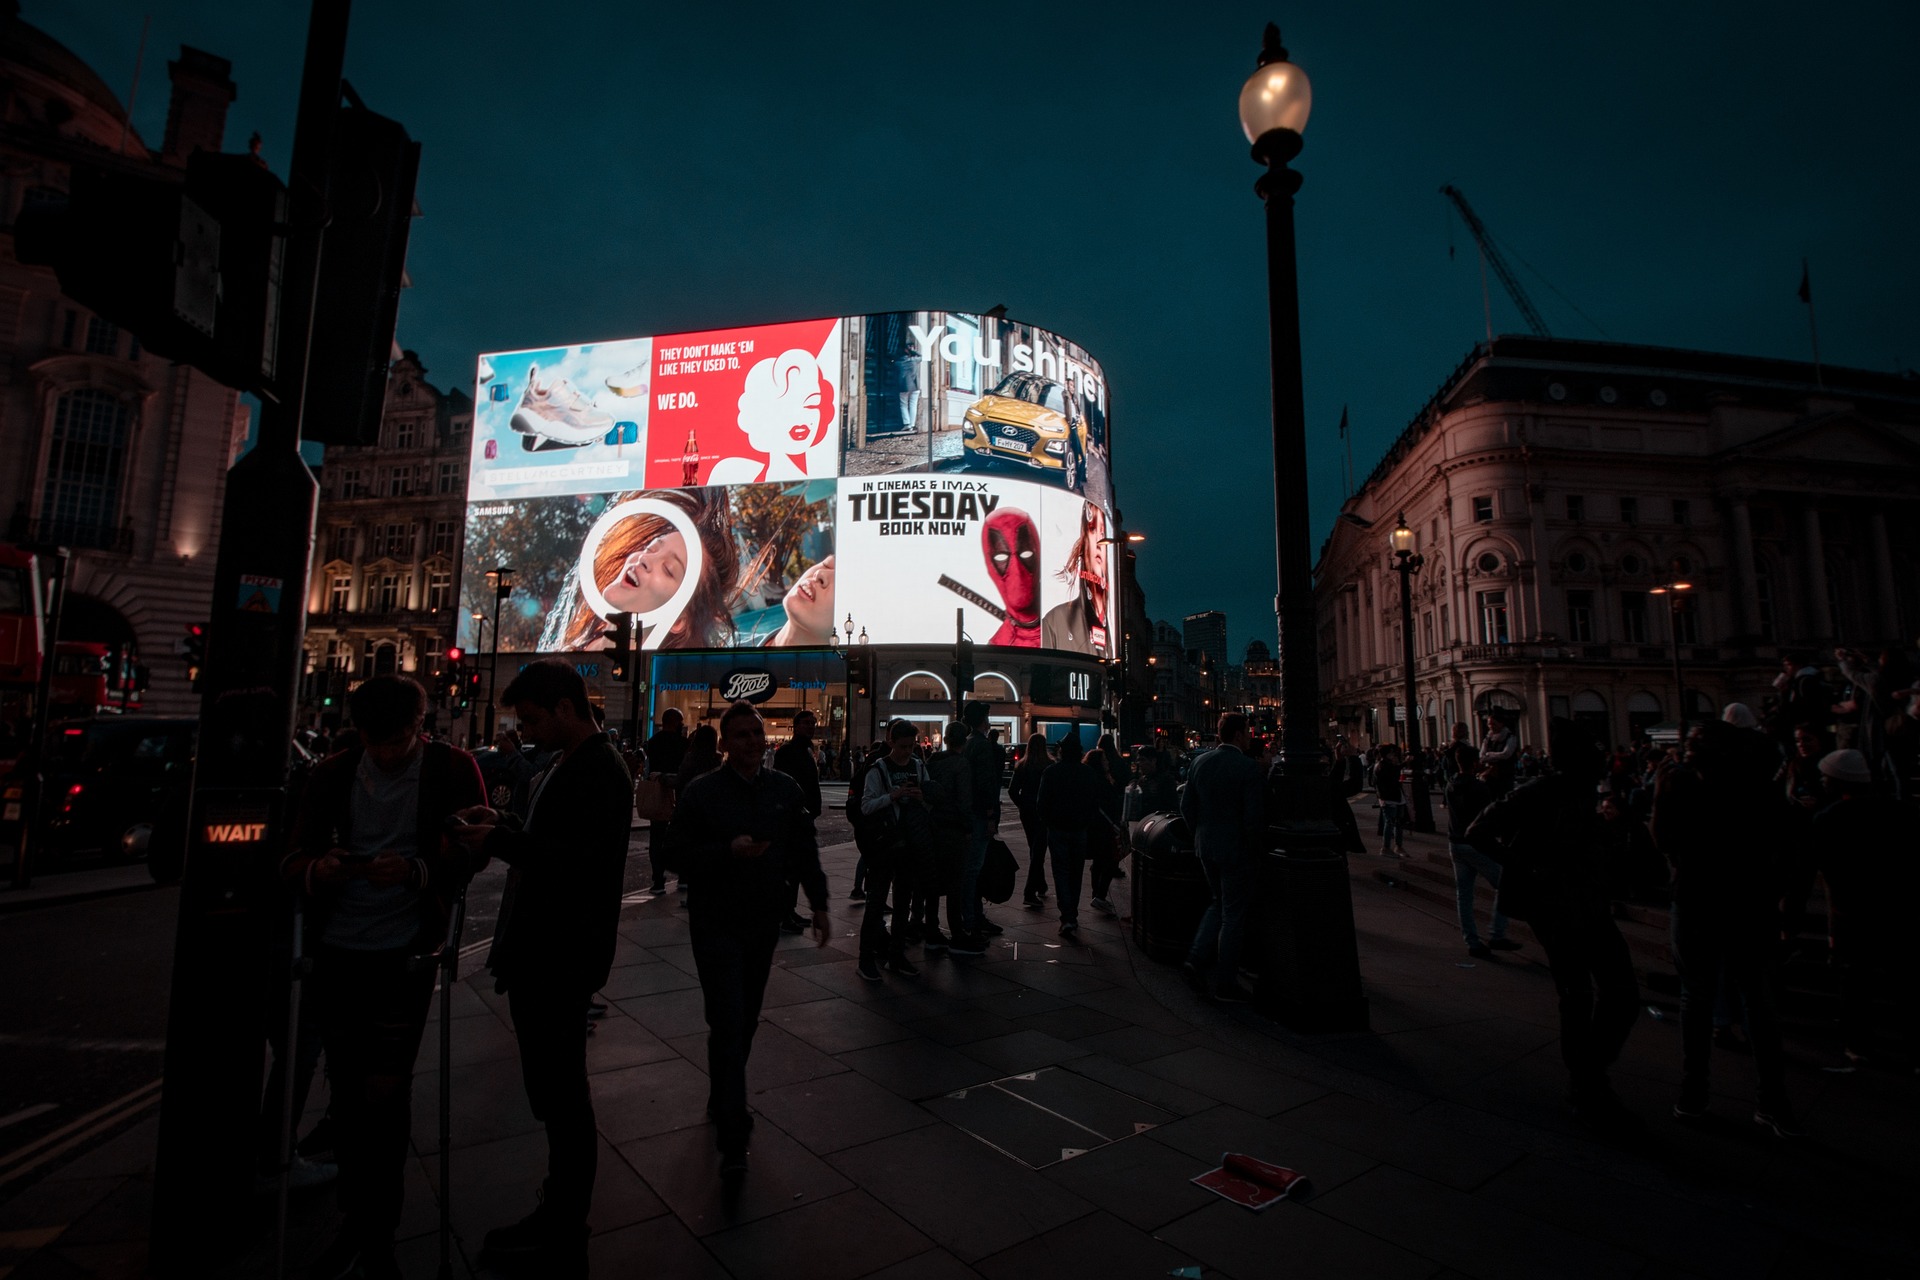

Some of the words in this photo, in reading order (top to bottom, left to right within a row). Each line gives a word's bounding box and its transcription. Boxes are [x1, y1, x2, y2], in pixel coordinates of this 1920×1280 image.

[659, 347, 682, 361] THEY
[683, 344, 709, 359] DON'T
[710, 341, 736, 357] MAKE
[737, 340, 754, 354] 'EM
[909, 325, 1000, 367] You
[659, 362, 678, 376] LIKE
[679, 360, 702, 374] THEY
[703, 358, 726, 372] USED
[727, 356, 741, 370] TO.
[657, 392, 677, 411] WE
[678, 391, 698, 409] DO.
[863, 482, 873, 492] IN
[877, 480, 926, 491] CINEMAS
[930, 480, 937, 490] &
[942, 480, 989, 492] IMAX
[473, 505, 515, 517] SAMSUNG
[848, 491, 1000, 522] TUESDAY
[879, 521, 924, 536] BOOK
[928, 521, 966, 536] NOW
[244, 575, 278, 588] PIZZA
[659, 681, 711, 693] pharmacy
[723, 673, 770, 699] Boots
[789, 679, 827, 691] beauty
[1069, 671, 1090, 701] GAP
[207, 823, 266, 842] WAIT
